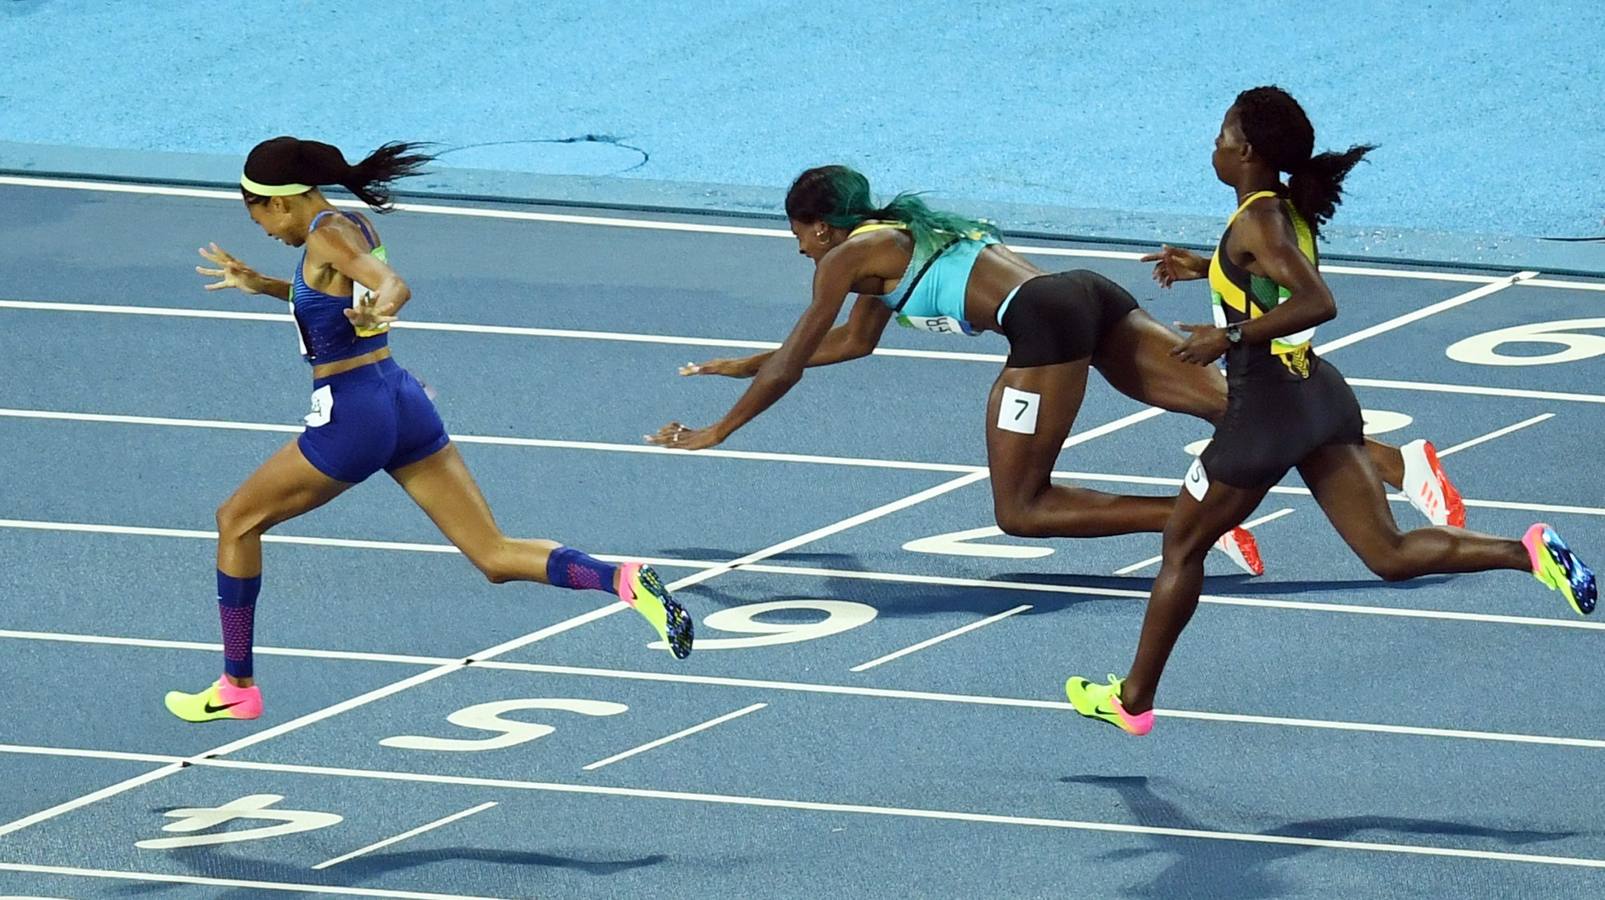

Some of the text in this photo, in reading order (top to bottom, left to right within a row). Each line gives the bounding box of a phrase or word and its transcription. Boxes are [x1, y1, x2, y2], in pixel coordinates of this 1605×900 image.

[1015, 398, 1029, 421] 7
[378, 697, 630, 752] 5
[134, 793, 344, 850] 4
